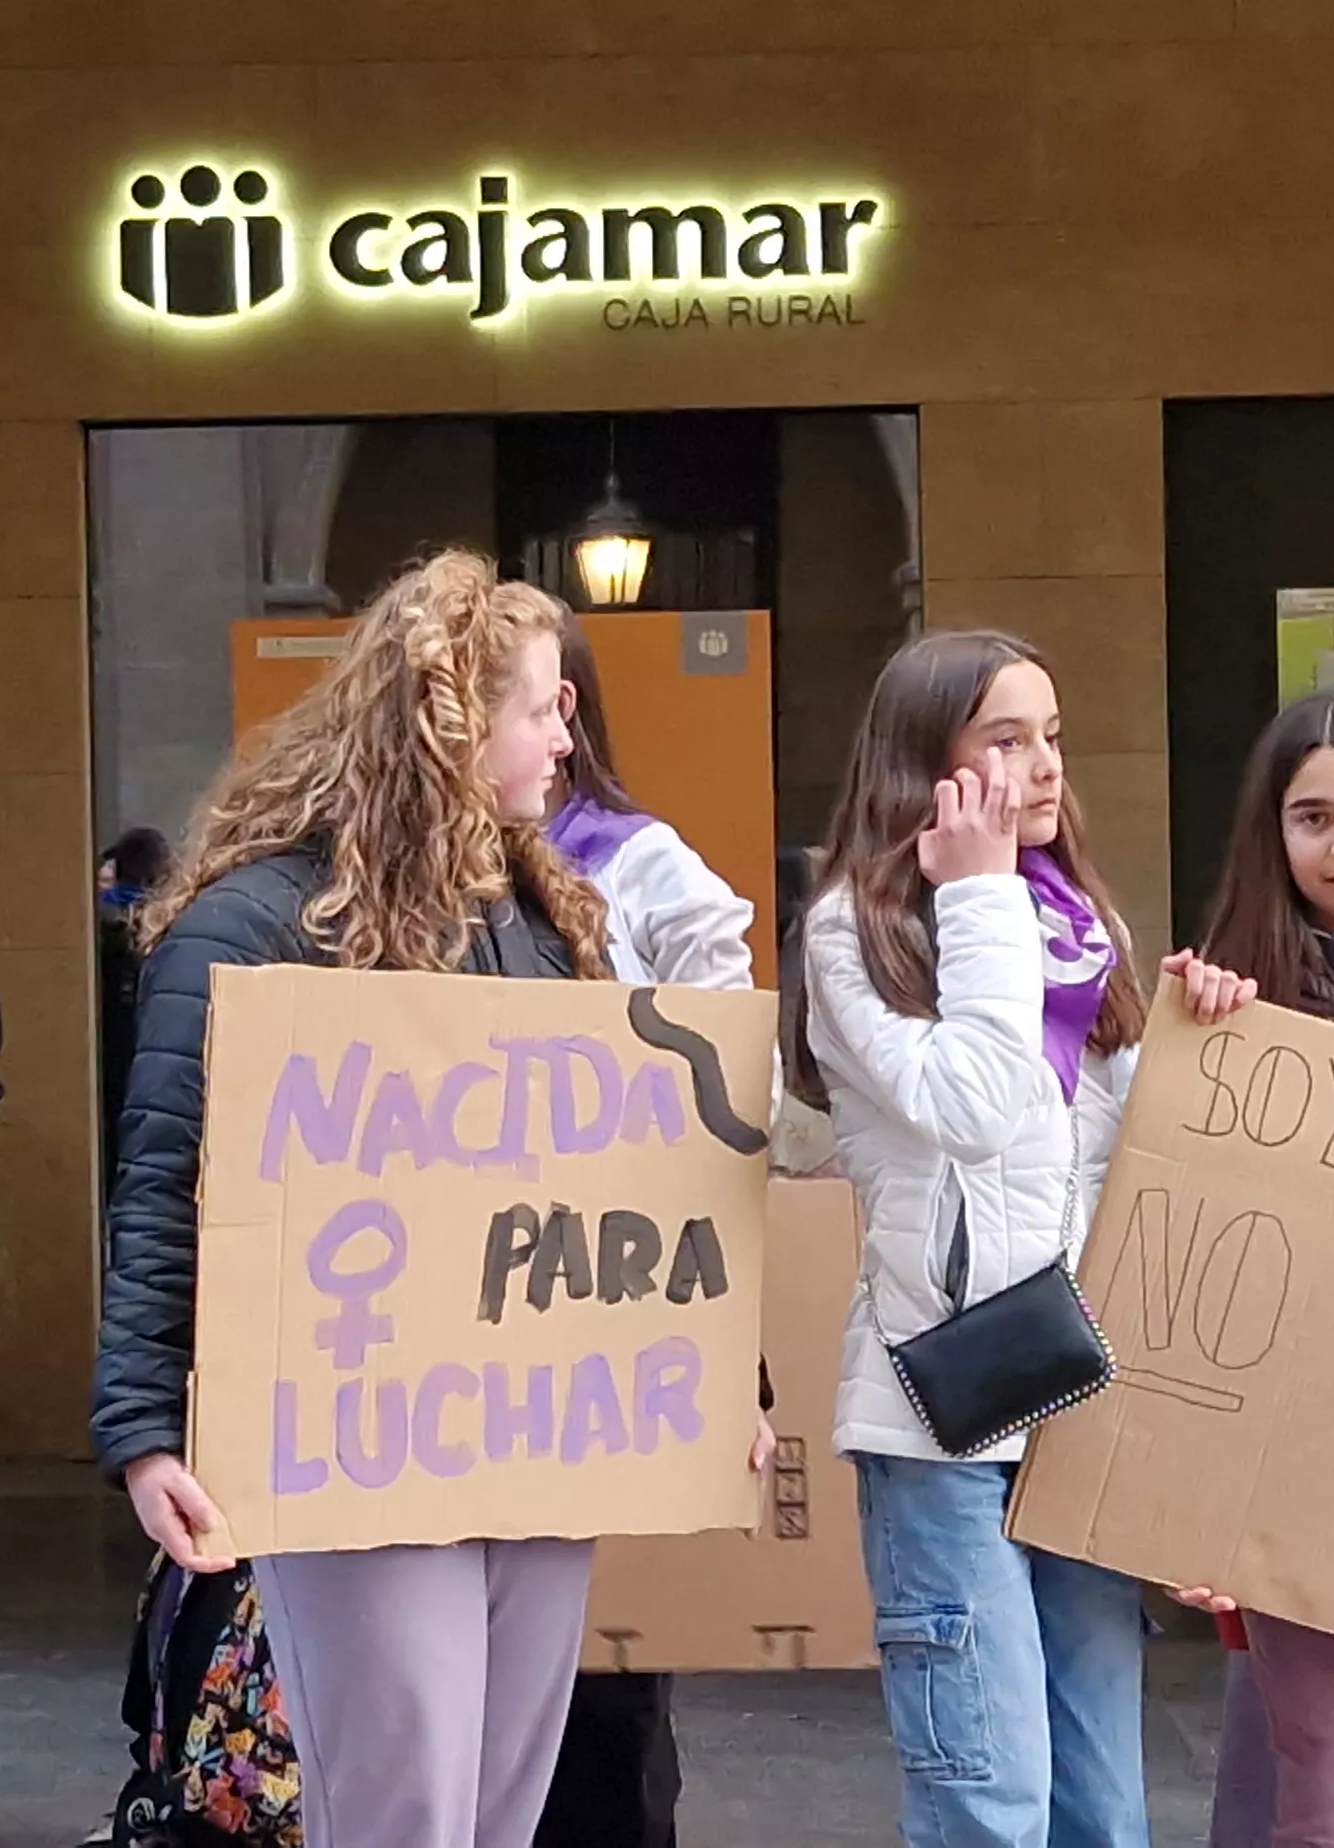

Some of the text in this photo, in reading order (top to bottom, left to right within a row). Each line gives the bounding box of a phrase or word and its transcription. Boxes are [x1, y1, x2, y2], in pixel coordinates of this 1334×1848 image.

[328, 176, 879, 320] cajamar
[602, 295, 868, 332] CAJA RURAL
[259, 1035, 686, 1183] NACIDA
[476, 1201, 730, 1325] PARA
[1095, 1187, 1292, 1371] NO
[271, 1335, 705, 1496] LUCHAR
